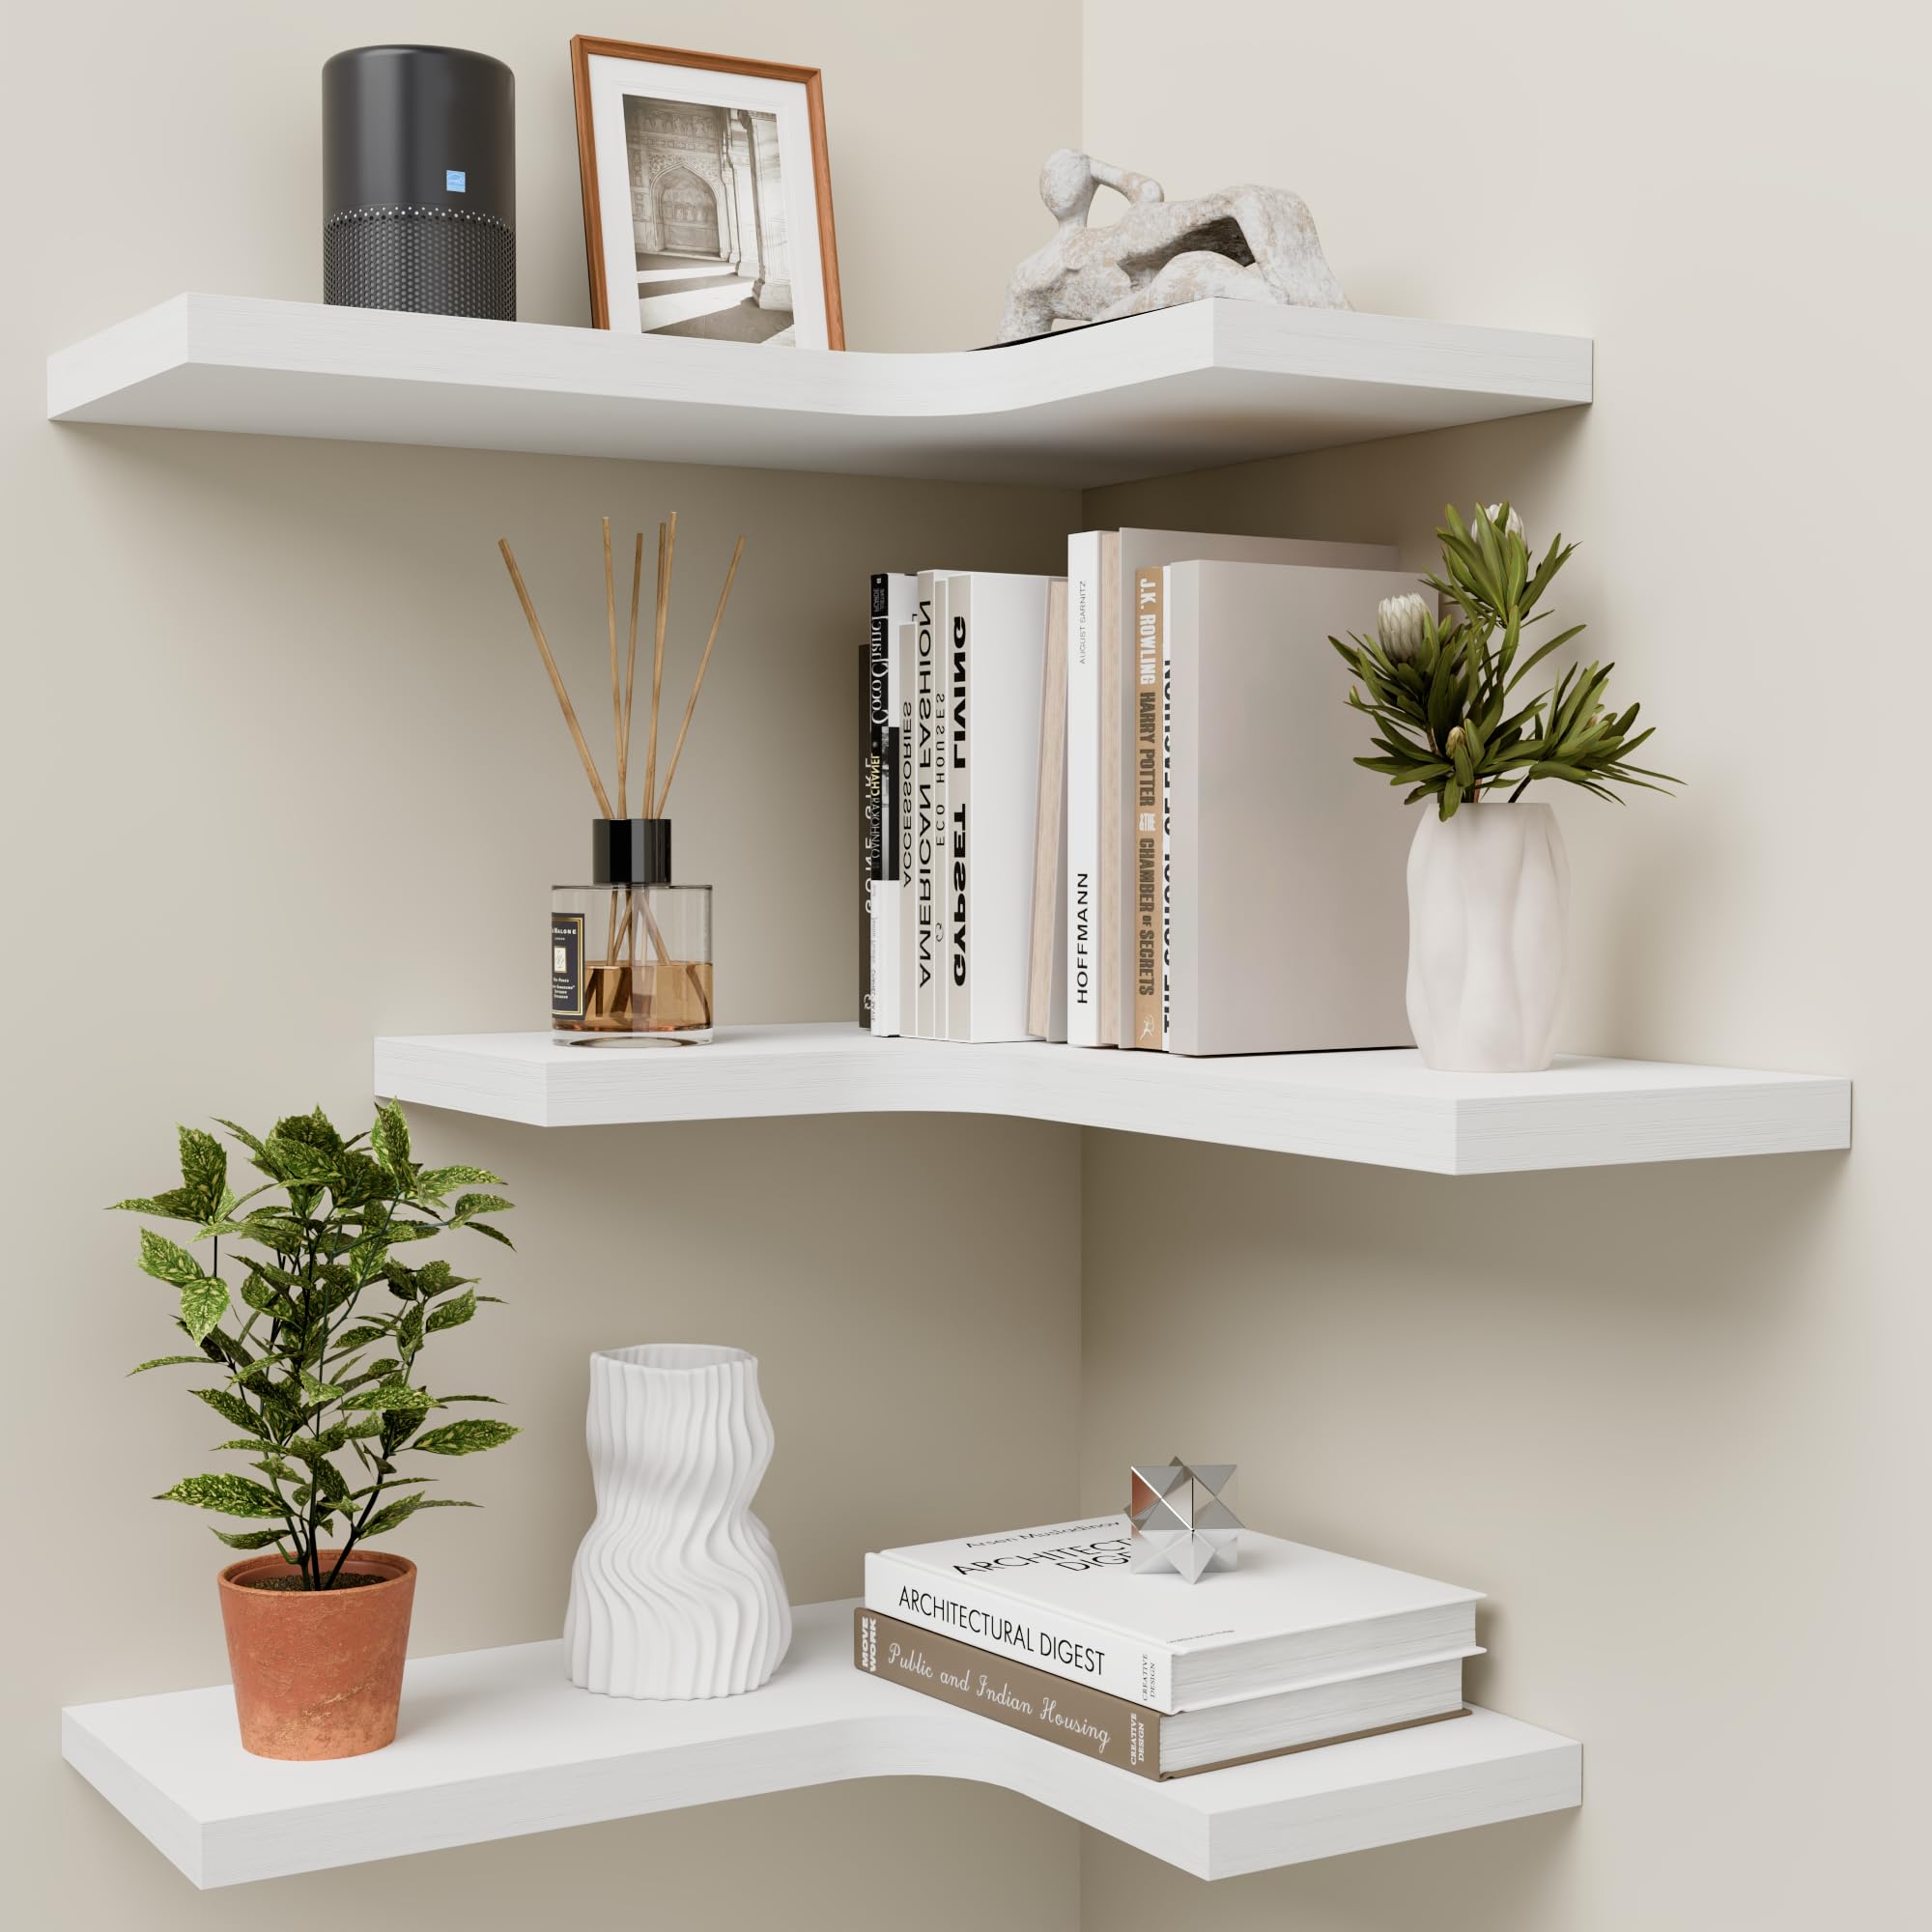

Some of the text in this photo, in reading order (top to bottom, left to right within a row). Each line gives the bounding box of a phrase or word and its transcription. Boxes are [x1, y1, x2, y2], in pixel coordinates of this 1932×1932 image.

[1140, 578, 1156, 685] J.K. ROWLING
[1140, 692, 1155, 744] HARRY
[1140, 749, 1155, 807] POTTER
[1139, 838, 1155, 913] CHAMBER
[1077, 873, 1088, 1004] HOFFMANN
[1142, 915, 1152, 927] OF
[1139, 929, 1154, 996] SECRETS
[952, 1538, 1131, 1576] ARCHITECT
[899, 1585, 1105, 1675] ARCHITECTURAL DIGEST
[888, 1642, 1111, 1754] Public and Indian Housing
